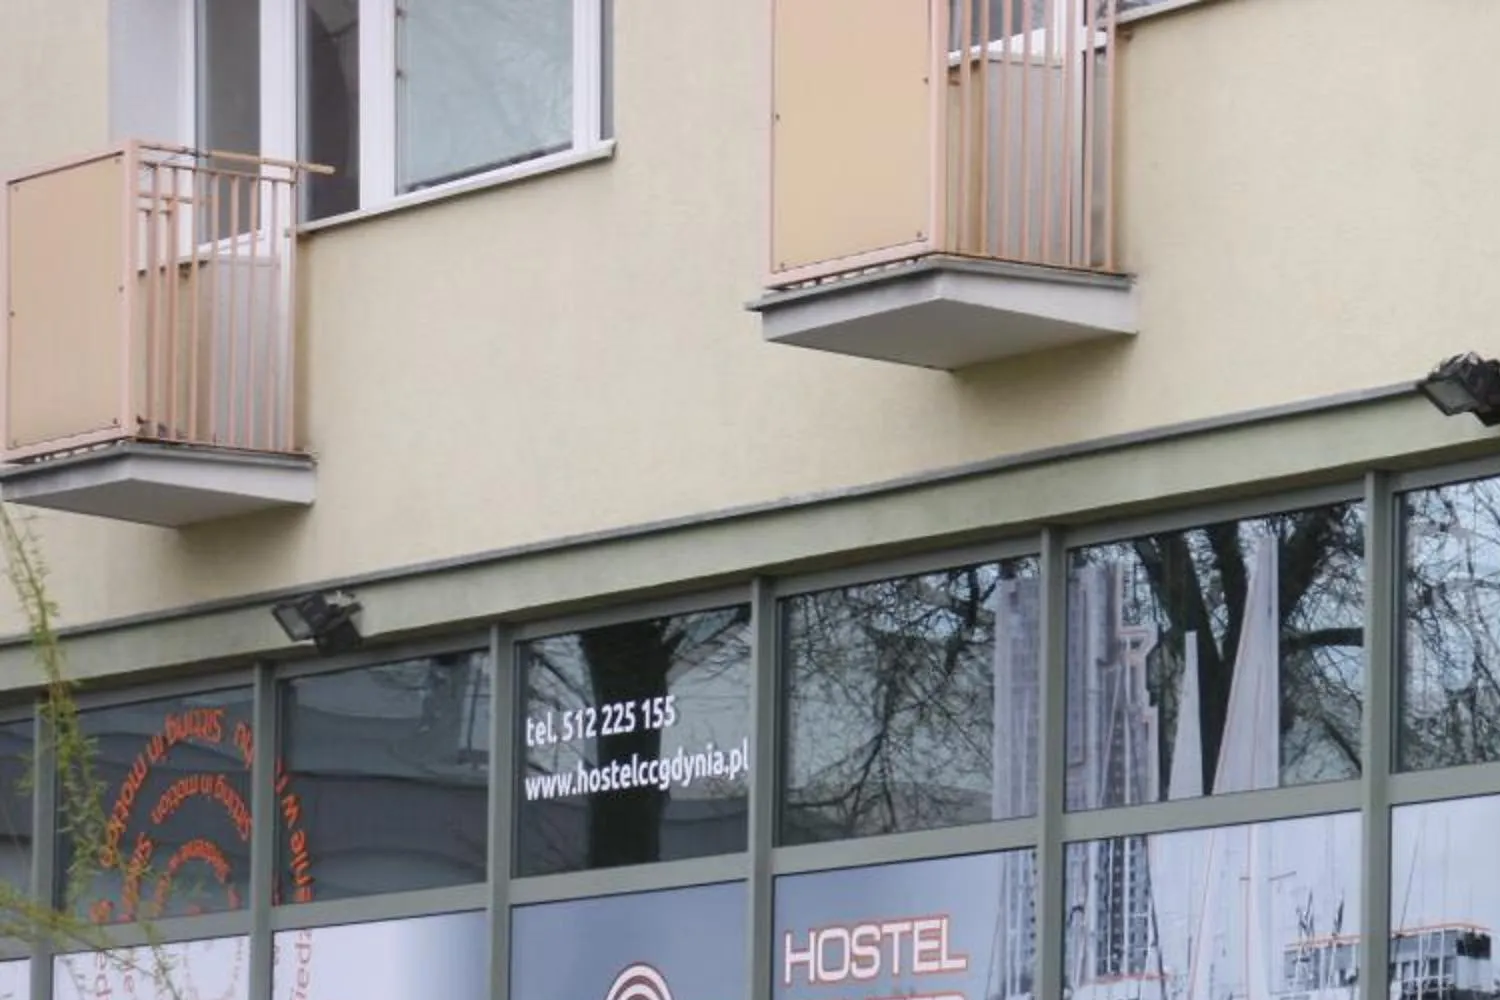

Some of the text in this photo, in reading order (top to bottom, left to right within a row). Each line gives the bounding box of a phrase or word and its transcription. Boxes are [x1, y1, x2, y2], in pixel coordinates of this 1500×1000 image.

[526, 695, 676, 747] tel. 512 225 155
[524, 737, 750, 801] www.hostelccgdynia.pl
[784, 914, 967, 985] HOSTEL
